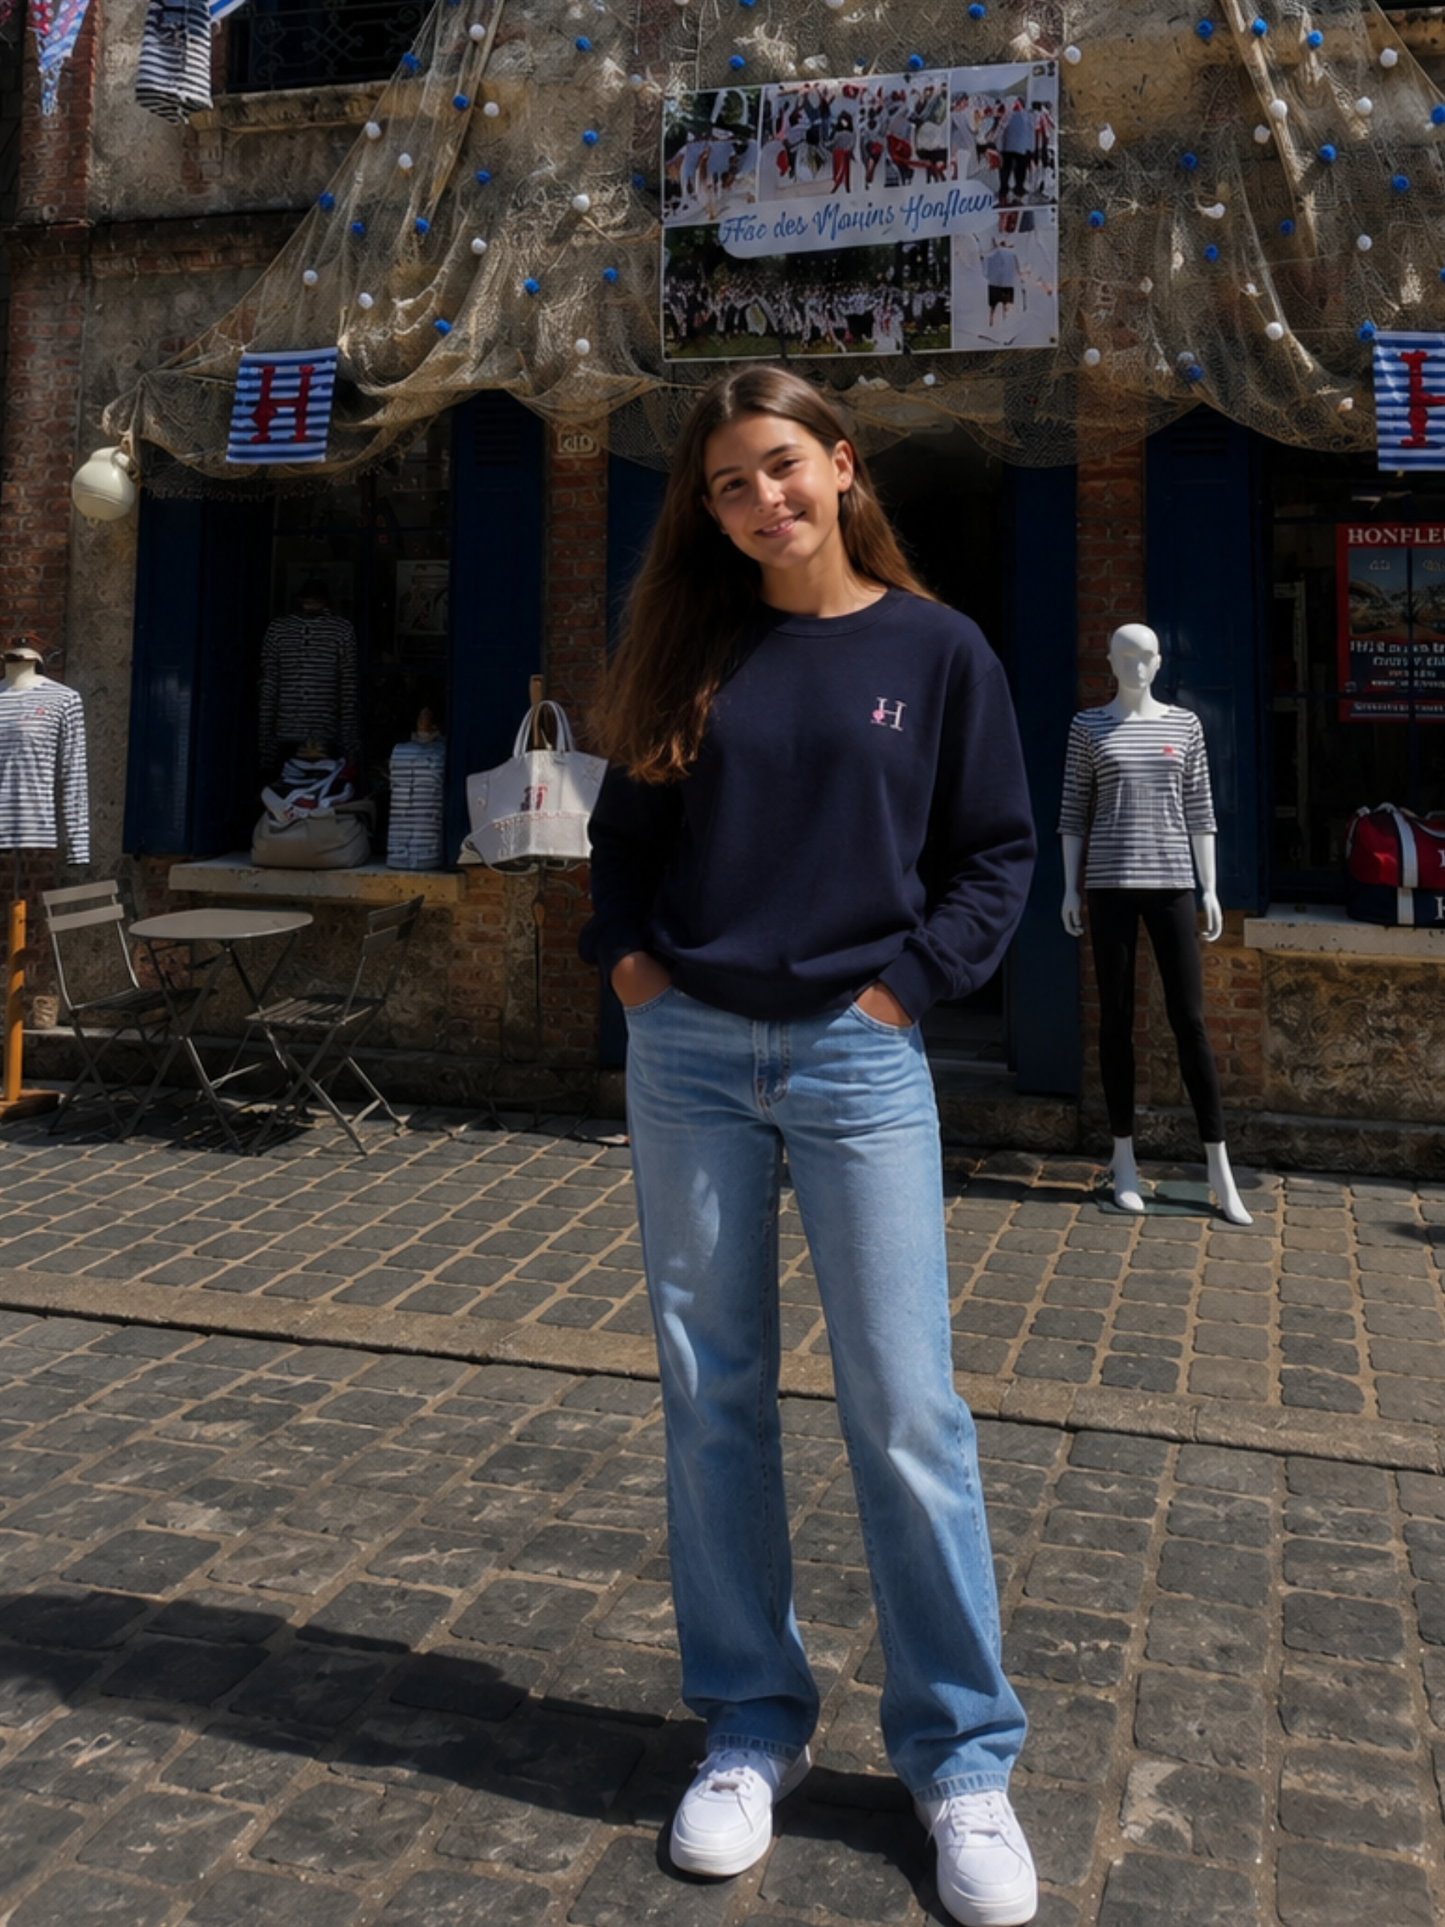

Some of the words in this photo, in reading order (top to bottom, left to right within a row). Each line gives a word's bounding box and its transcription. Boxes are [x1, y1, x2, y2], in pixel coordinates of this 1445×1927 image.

[773, 211, 809, 238] des
[1347, 527, 1445, 545] HONFLE
[870, 696, 908, 733] H
